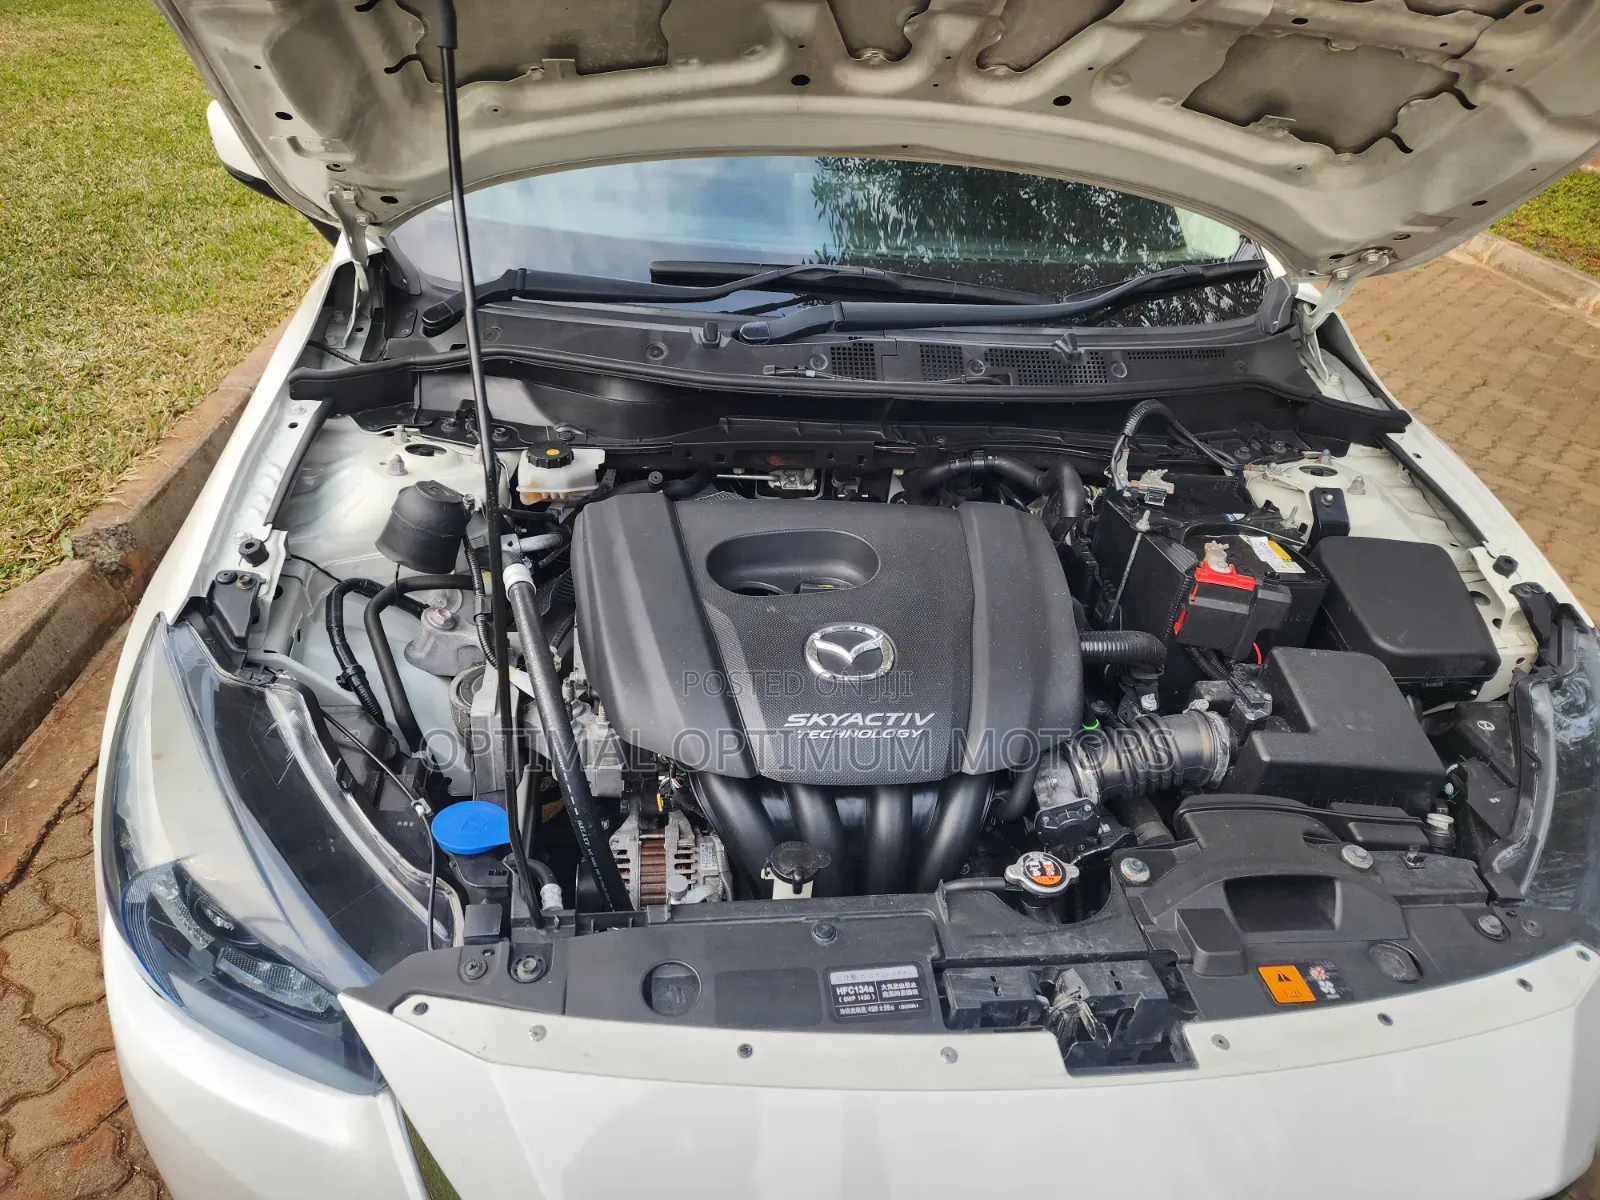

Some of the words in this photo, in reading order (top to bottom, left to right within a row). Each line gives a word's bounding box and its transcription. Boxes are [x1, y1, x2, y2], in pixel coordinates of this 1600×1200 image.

[784, 712, 935, 727] SKYACTIV
[798, 729, 925, 739] TECHNOLOGY
[836, 985, 875, 996] HFC134a
